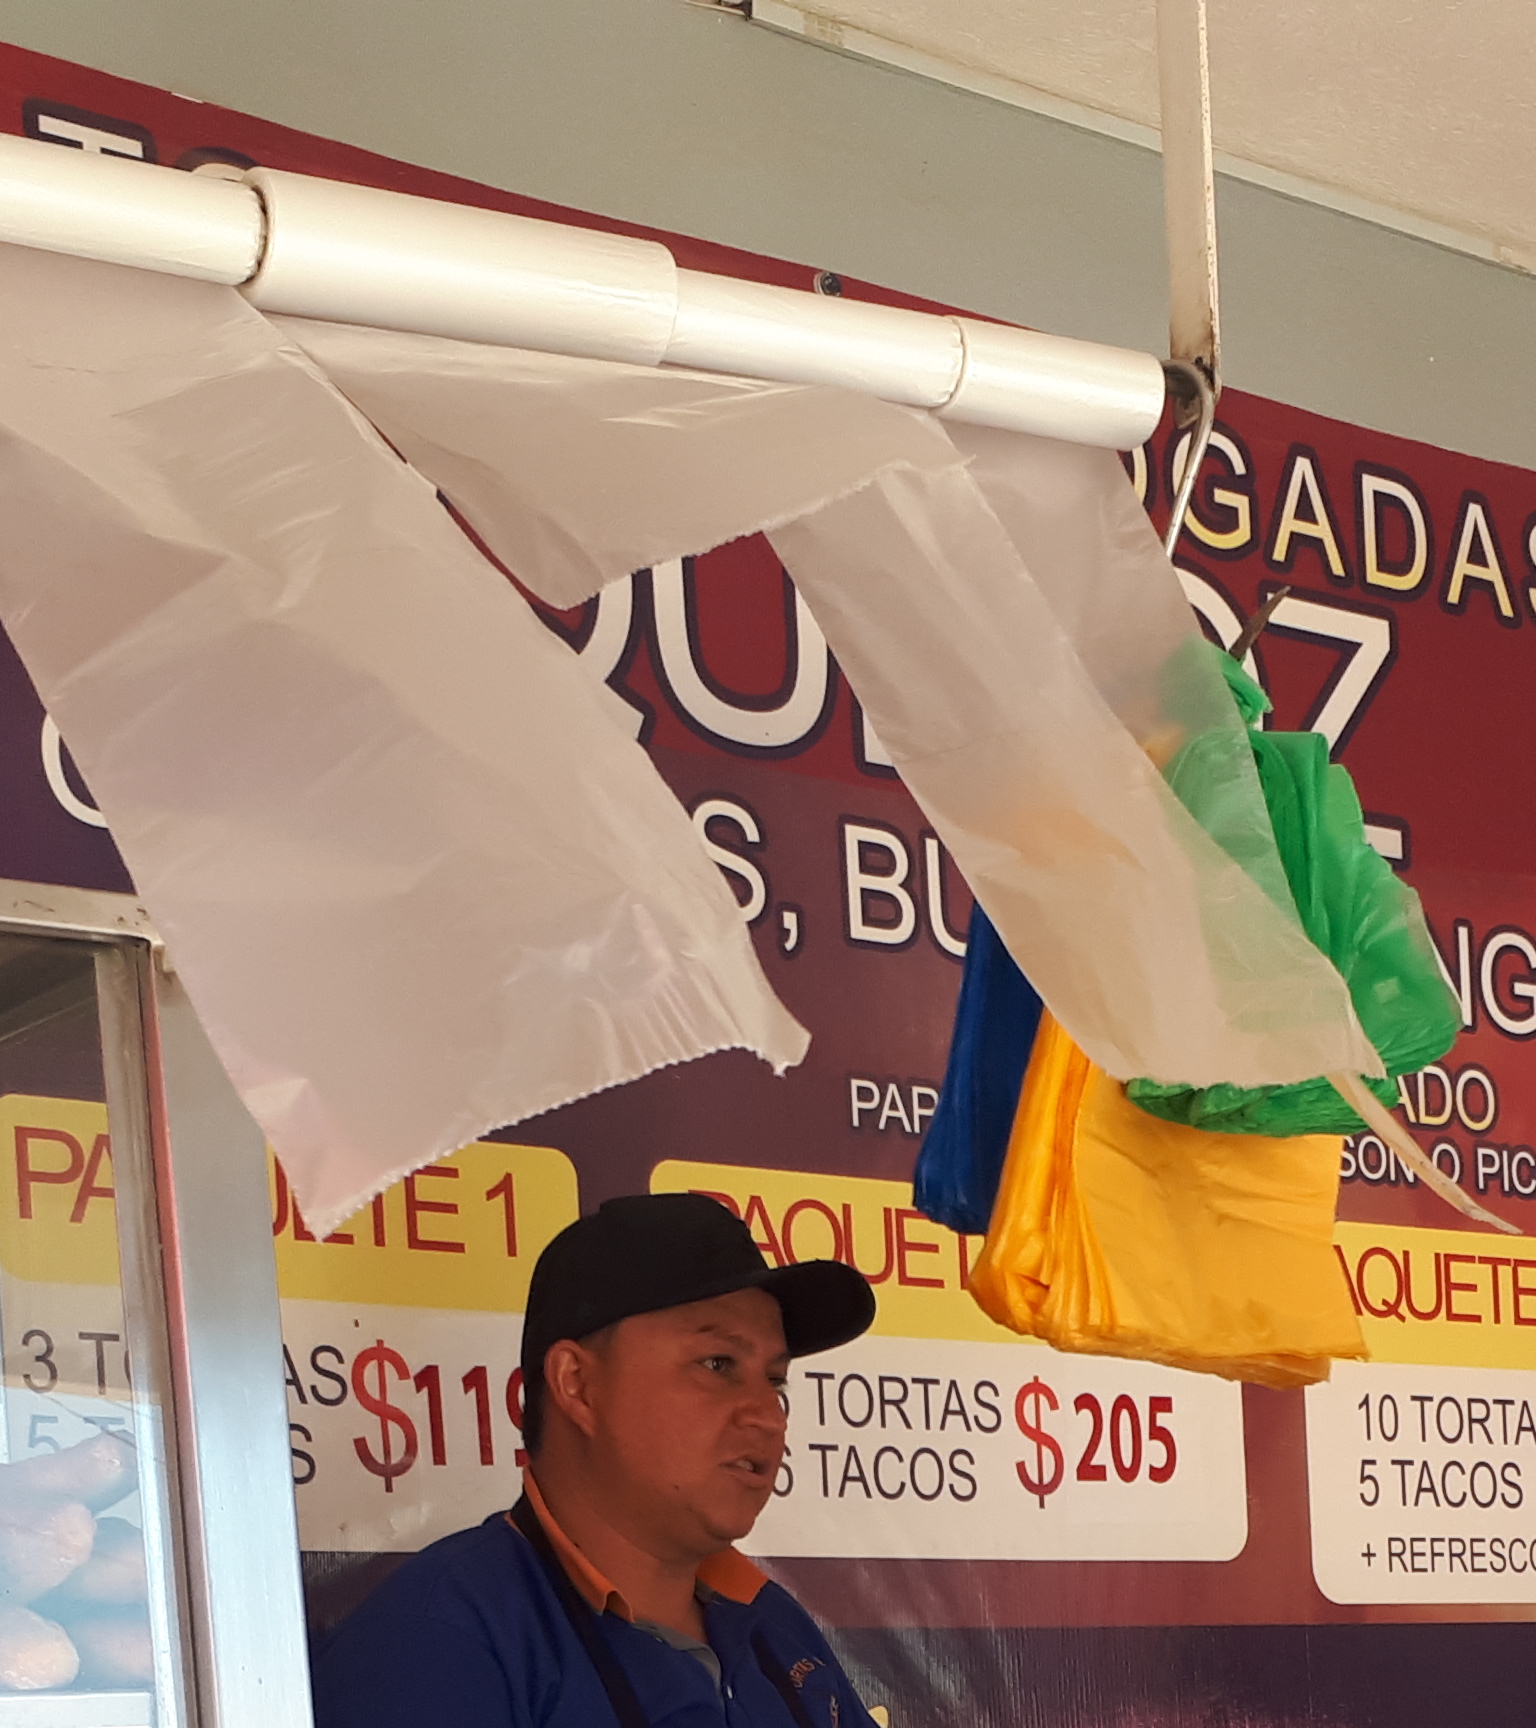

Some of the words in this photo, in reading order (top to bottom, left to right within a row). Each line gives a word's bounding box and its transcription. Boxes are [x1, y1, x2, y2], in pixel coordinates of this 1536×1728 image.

[1431, 1143, 1461, 1185] O
[485, 1171, 518, 1257] 1
[22, 1329, 59, 1394] 3
[805, 1371, 1002, 1434] TORTAS
[1014, 1375, 1178, 1509] $205
[1357, 1393, 1399, 1443] 10
[808, 1443, 978, 1501] TACOS
[1359, 1459, 1381, 1507] 5
[1391, 1459, 1524, 1509] TACOS
